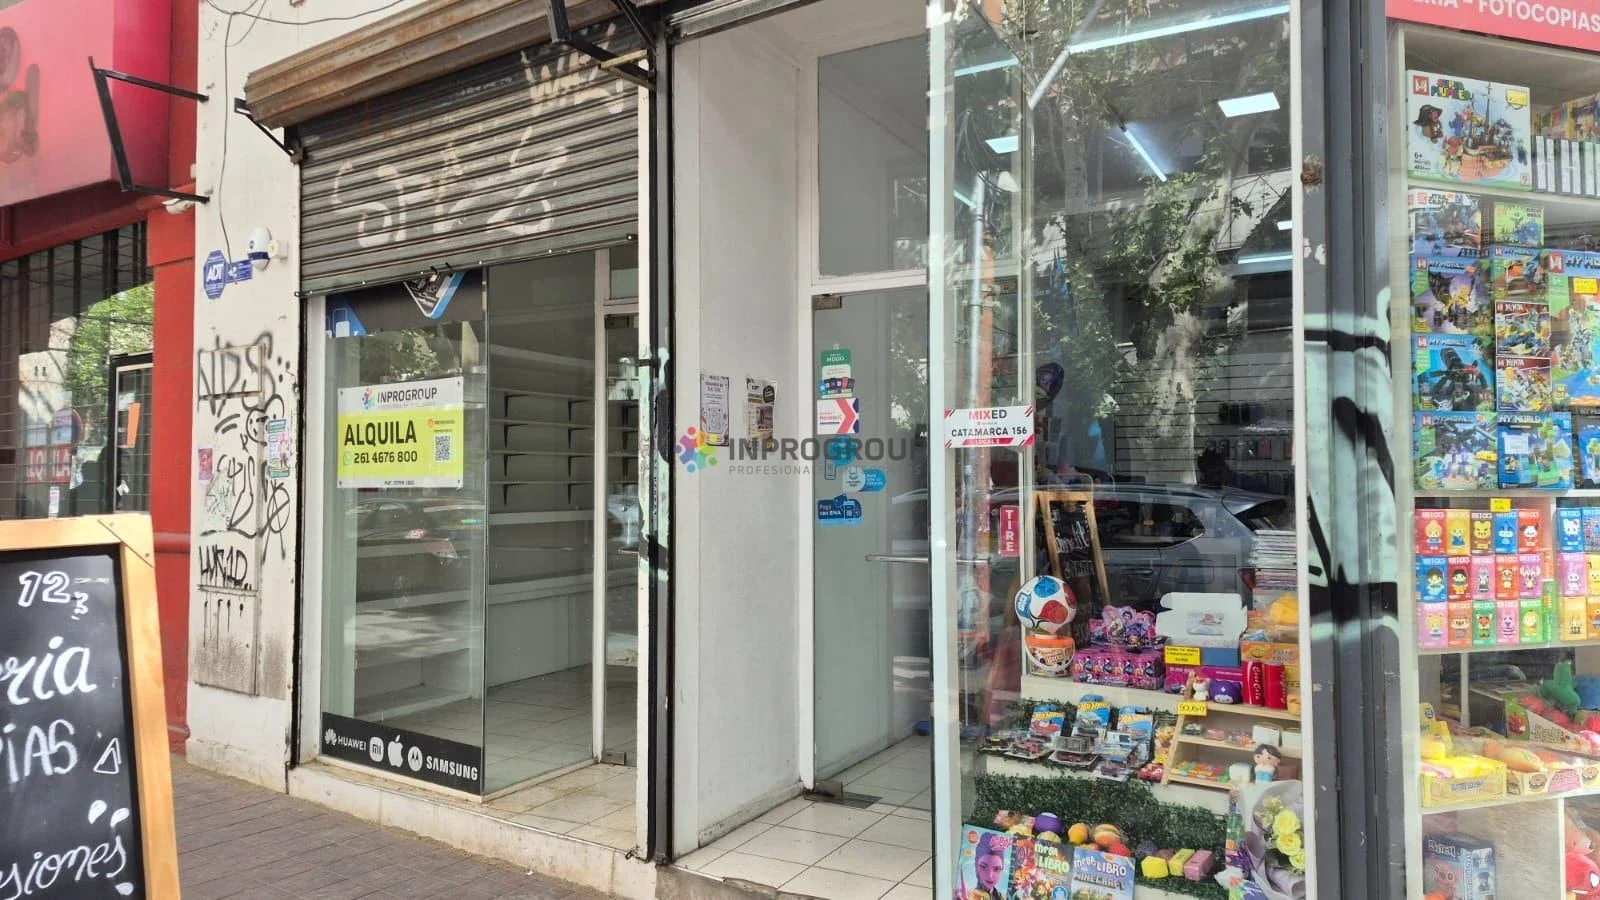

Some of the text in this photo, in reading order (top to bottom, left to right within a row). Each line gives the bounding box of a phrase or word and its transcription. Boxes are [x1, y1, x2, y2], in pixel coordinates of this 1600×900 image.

[206, 263, 224, 281] ADT
[377, 387, 438, 403] INPROGROUP
[968, 409, 1008, 420] MIXED
[343, 420, 418, 447] ALQUILA
[951, 426, 1028, 437] CATAMARCA 156
[354, 451, 418, 464] 261 4676 800
[1005, 509, 1015, 552] TIRE
[0, 636, 97, 705] ria
[337, 735, 367, 751] HUAWEI
[426, 755, 478, 781] SAMSUNG
[1039, 856, 1070, 873] LIBRO
[1097, 860, 1127, 877] LIBRO
